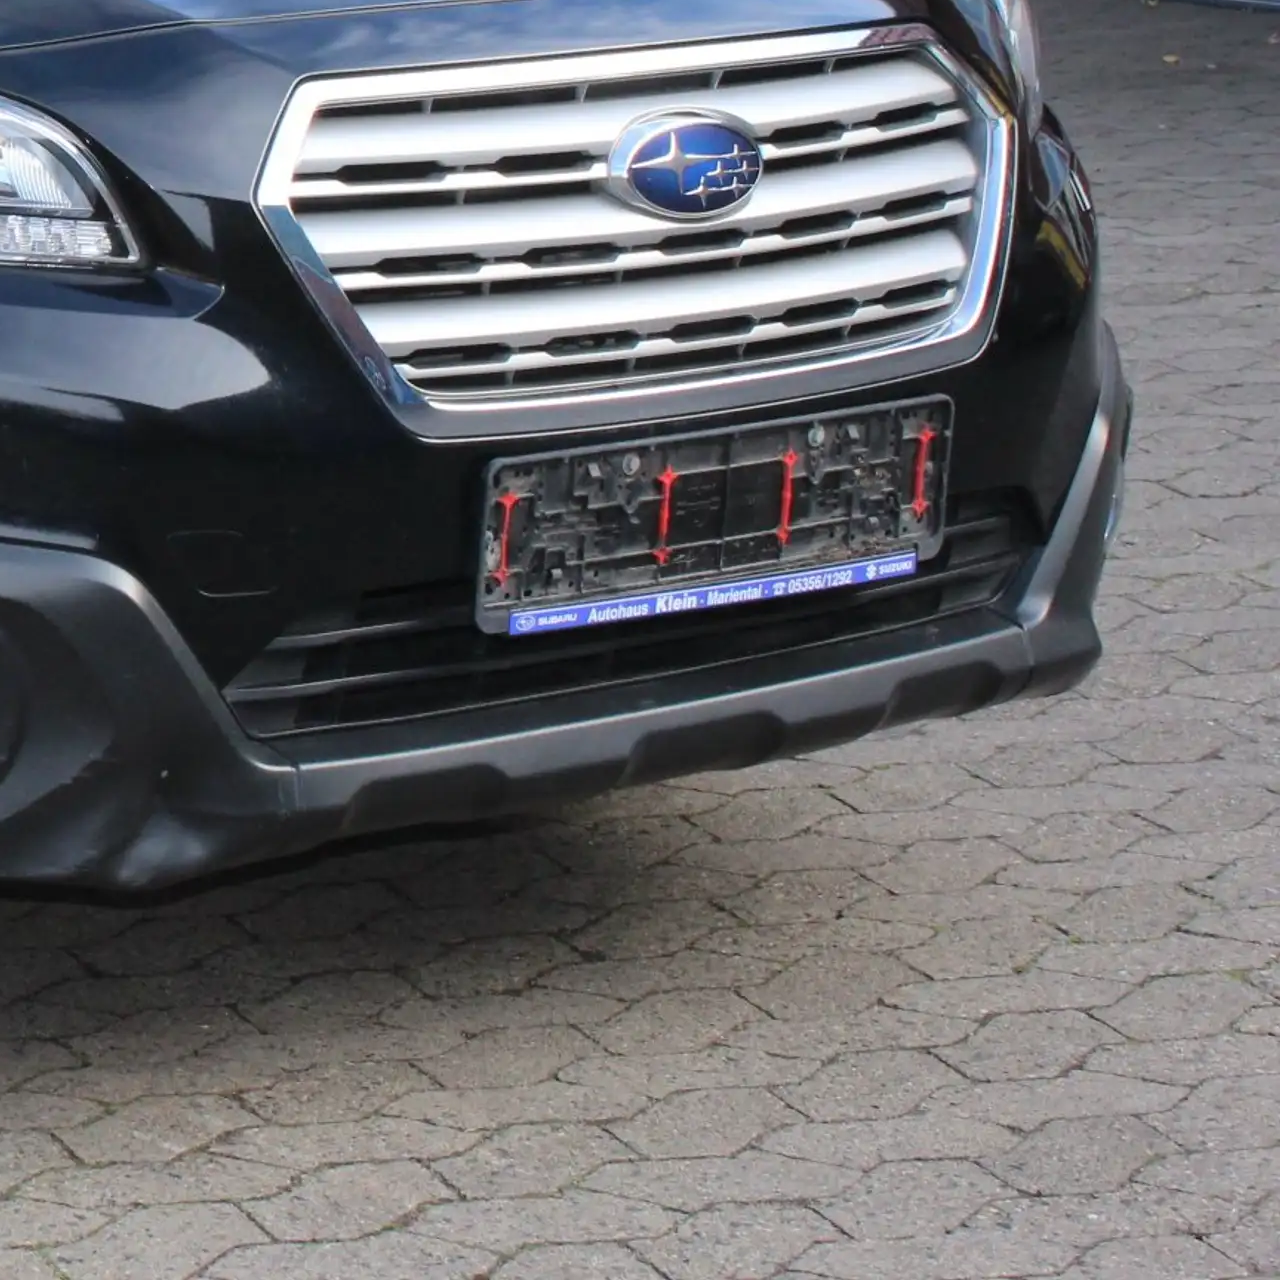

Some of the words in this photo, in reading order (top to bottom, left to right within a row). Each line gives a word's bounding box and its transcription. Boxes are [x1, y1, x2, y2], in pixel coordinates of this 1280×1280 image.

[587, 602, 649, 624] Autohaus
[655, 593, 698, 613] Klein
[707, 585, 763, 606] Mariental
[788, 571, 853, 593] 05356/1292
